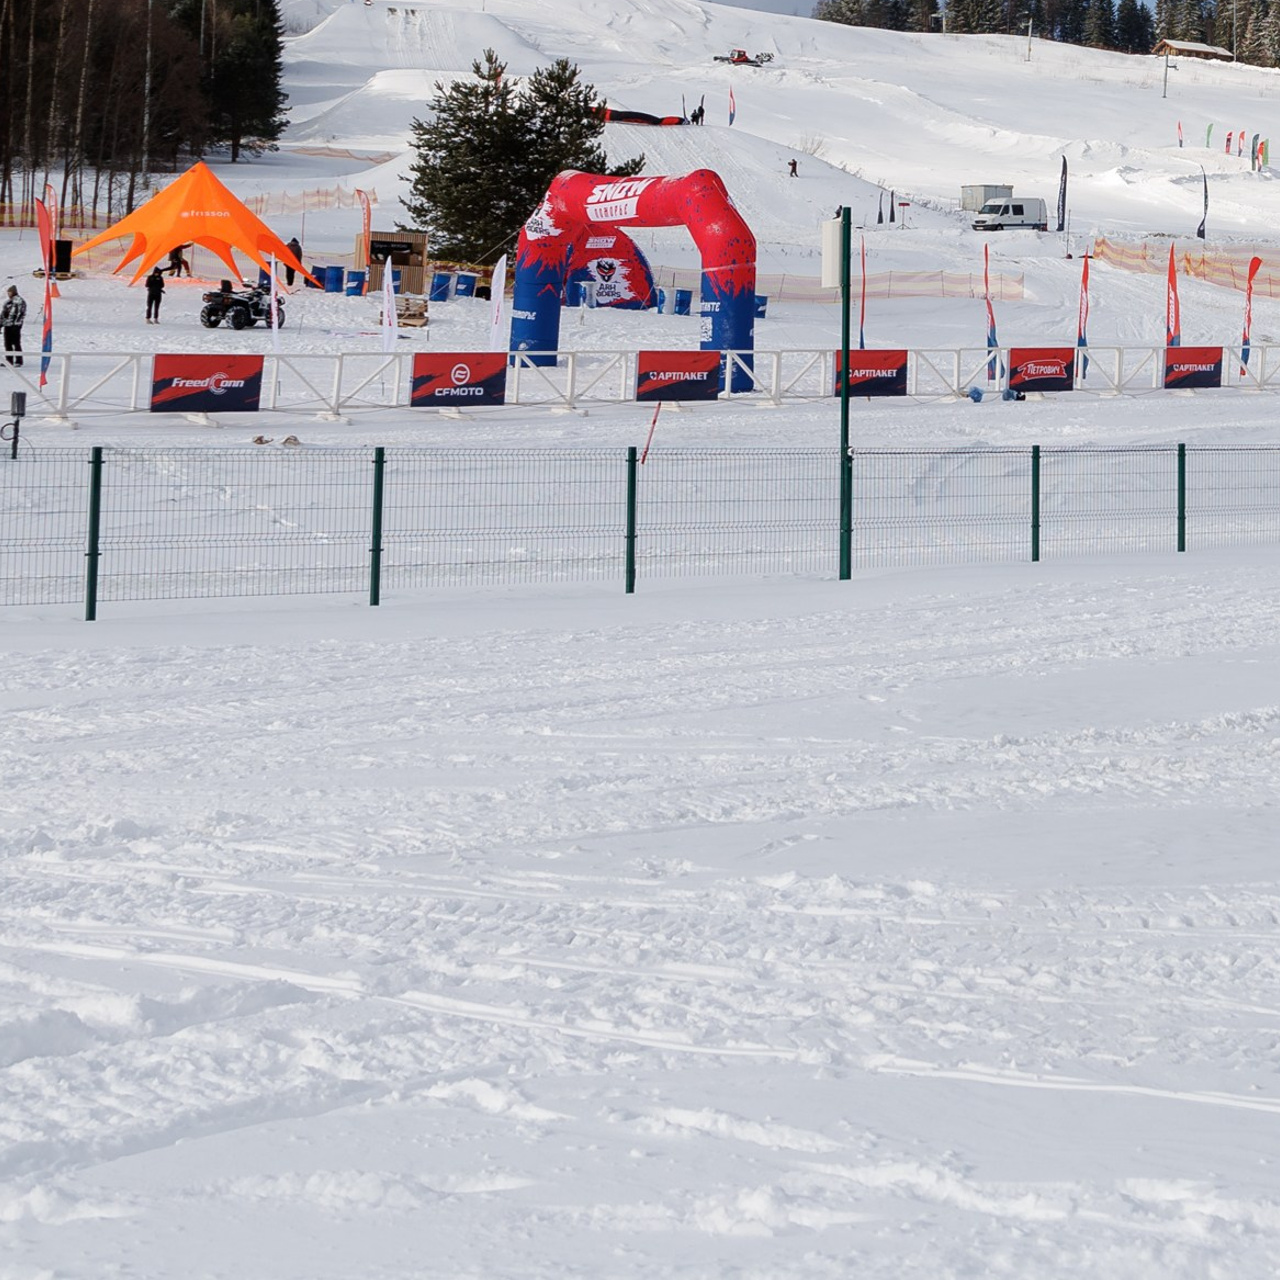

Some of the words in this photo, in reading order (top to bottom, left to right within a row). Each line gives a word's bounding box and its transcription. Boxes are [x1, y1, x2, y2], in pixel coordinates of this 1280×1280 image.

[586, 178, 656, 203] SNOW
[190, 209, 230, 217] frisson
[657, 371, 709, 381] АРТПАКЕТ
[171, 372, 244, 395] FreedConn
[434, 387, 484, 396] CFMOTO
